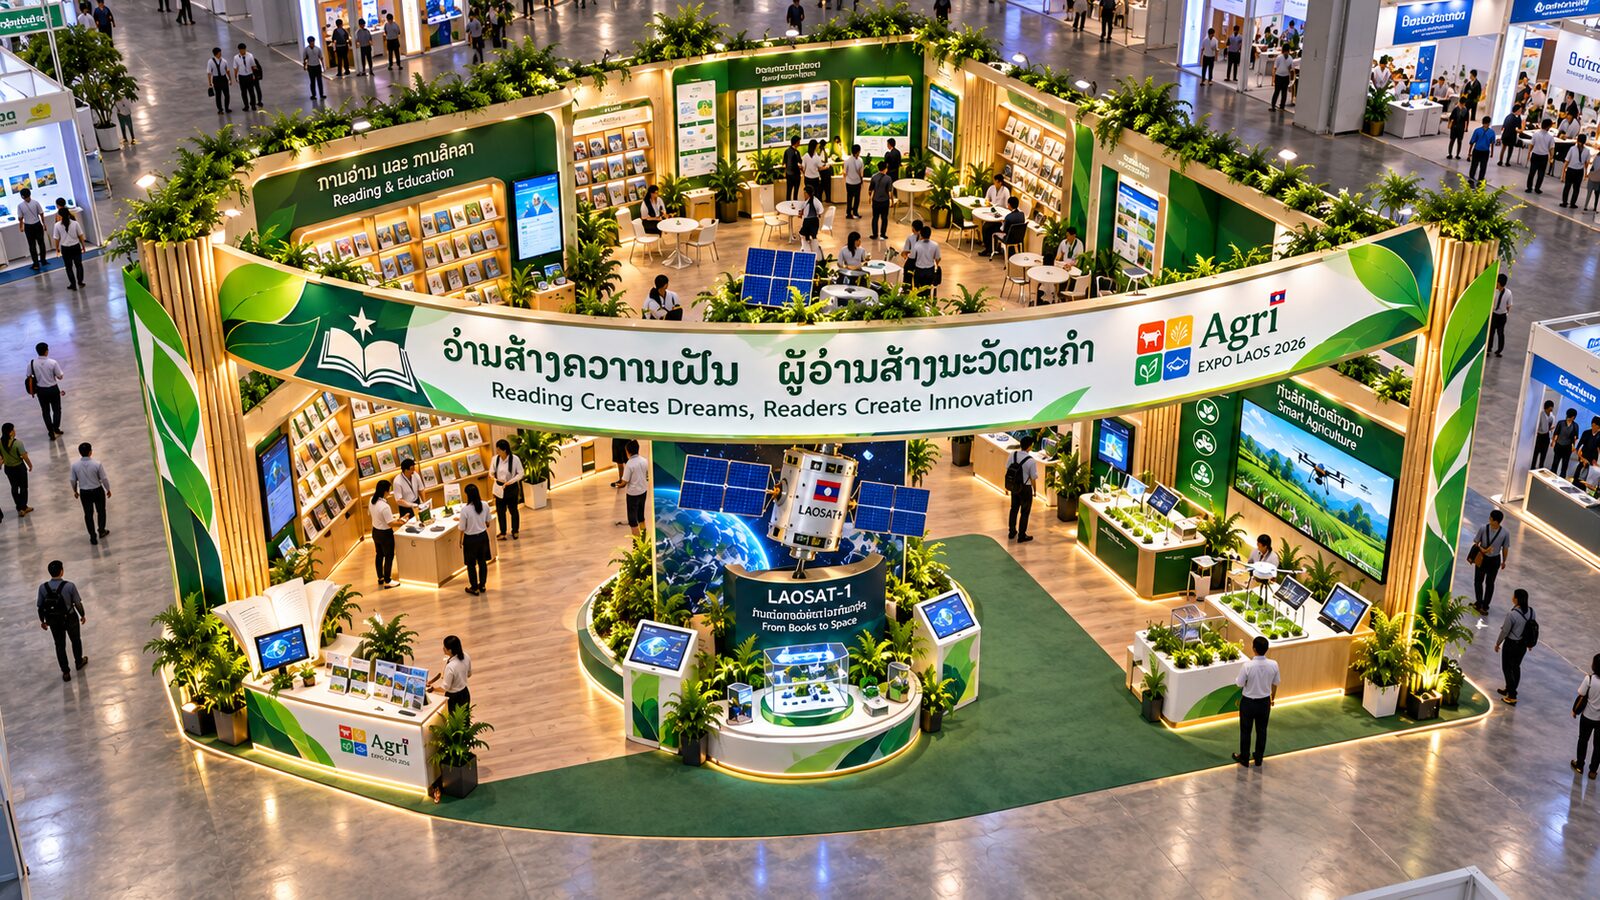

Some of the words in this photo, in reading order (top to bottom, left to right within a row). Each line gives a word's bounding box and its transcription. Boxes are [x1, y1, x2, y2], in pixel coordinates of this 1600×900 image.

[333, 186, 382, 207] Reading
[385, 181, 394, 193] &
[397, 168, 454, 190] Education
[1199, 305, 1278, 352] Agri
[1198, 355, 1232, 373] EXPO
[1236, 345, 1270, 365] LAOS
[1274, 336, 1306, 356] 2026
[492, 381, 573, 412] Reading
[581, 392, 660, 415] Creates
[668, 398, 755, 420] Dreams,
[764, 399, 847, 417] Readers
[855, 396, 922, 415] Create
[929, 386, 1033, 411] Innovation
[1277, 399, 1305, 423] Smart
[1305, 415, 1357, 451] Agriculture
[768, 583, 851, 604] LAOSAT-1
[762, 622, 786, 632] From
[788, 623, 817, 632] Books
[819, 622, 829, 630] to
[830, 617, 858, 630] Space
[371, 733, 409, 757] Agri
